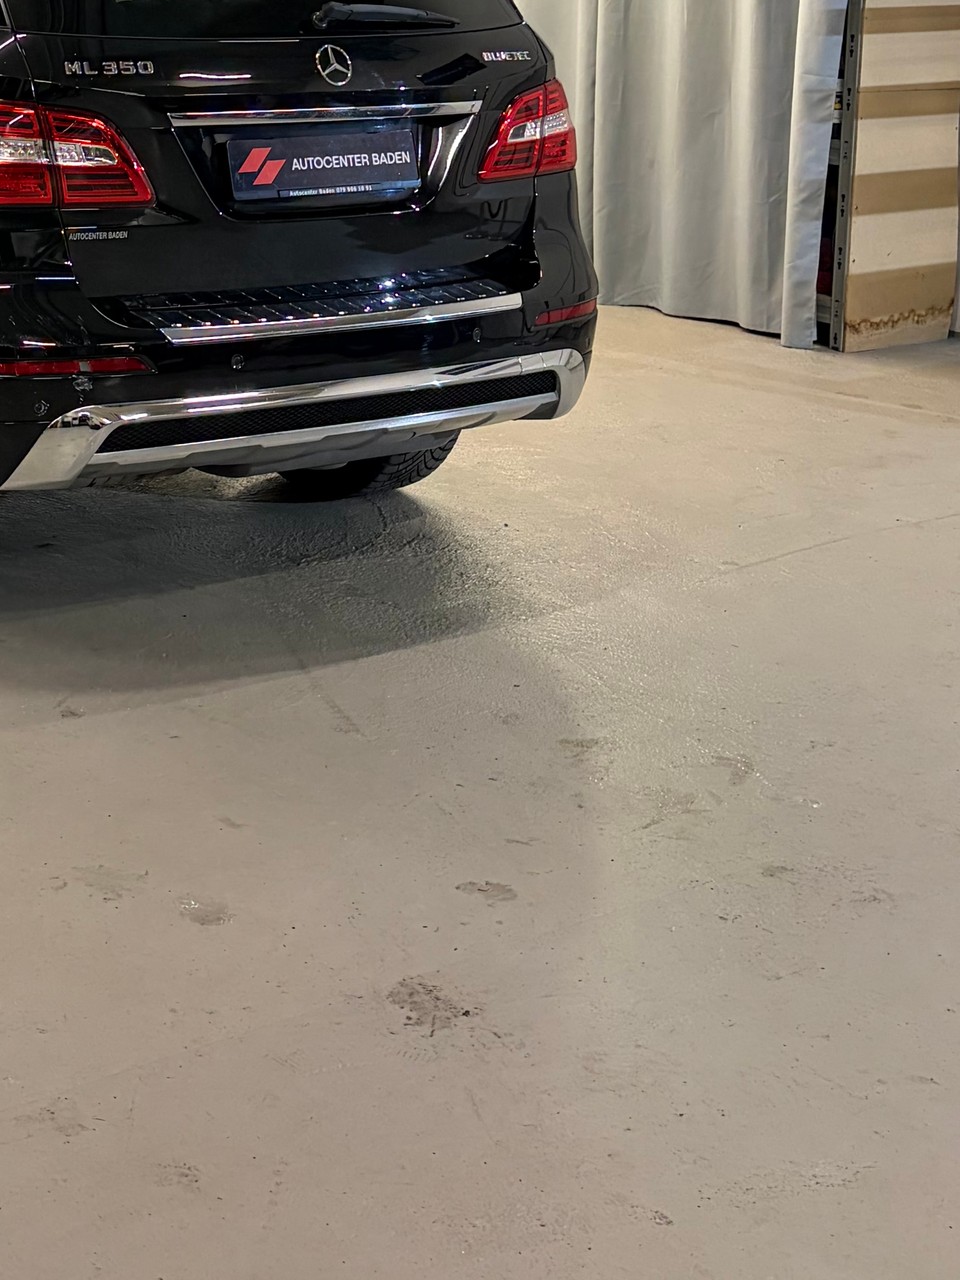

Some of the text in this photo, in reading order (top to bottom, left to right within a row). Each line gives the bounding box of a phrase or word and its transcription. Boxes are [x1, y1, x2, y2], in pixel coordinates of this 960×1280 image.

[64, 60, 154, 75] ML 350
[292, 151, 410, 170] AUTOCENTER BADEN
[69, 231, 128, 240] AUTOCENTER BADEN
